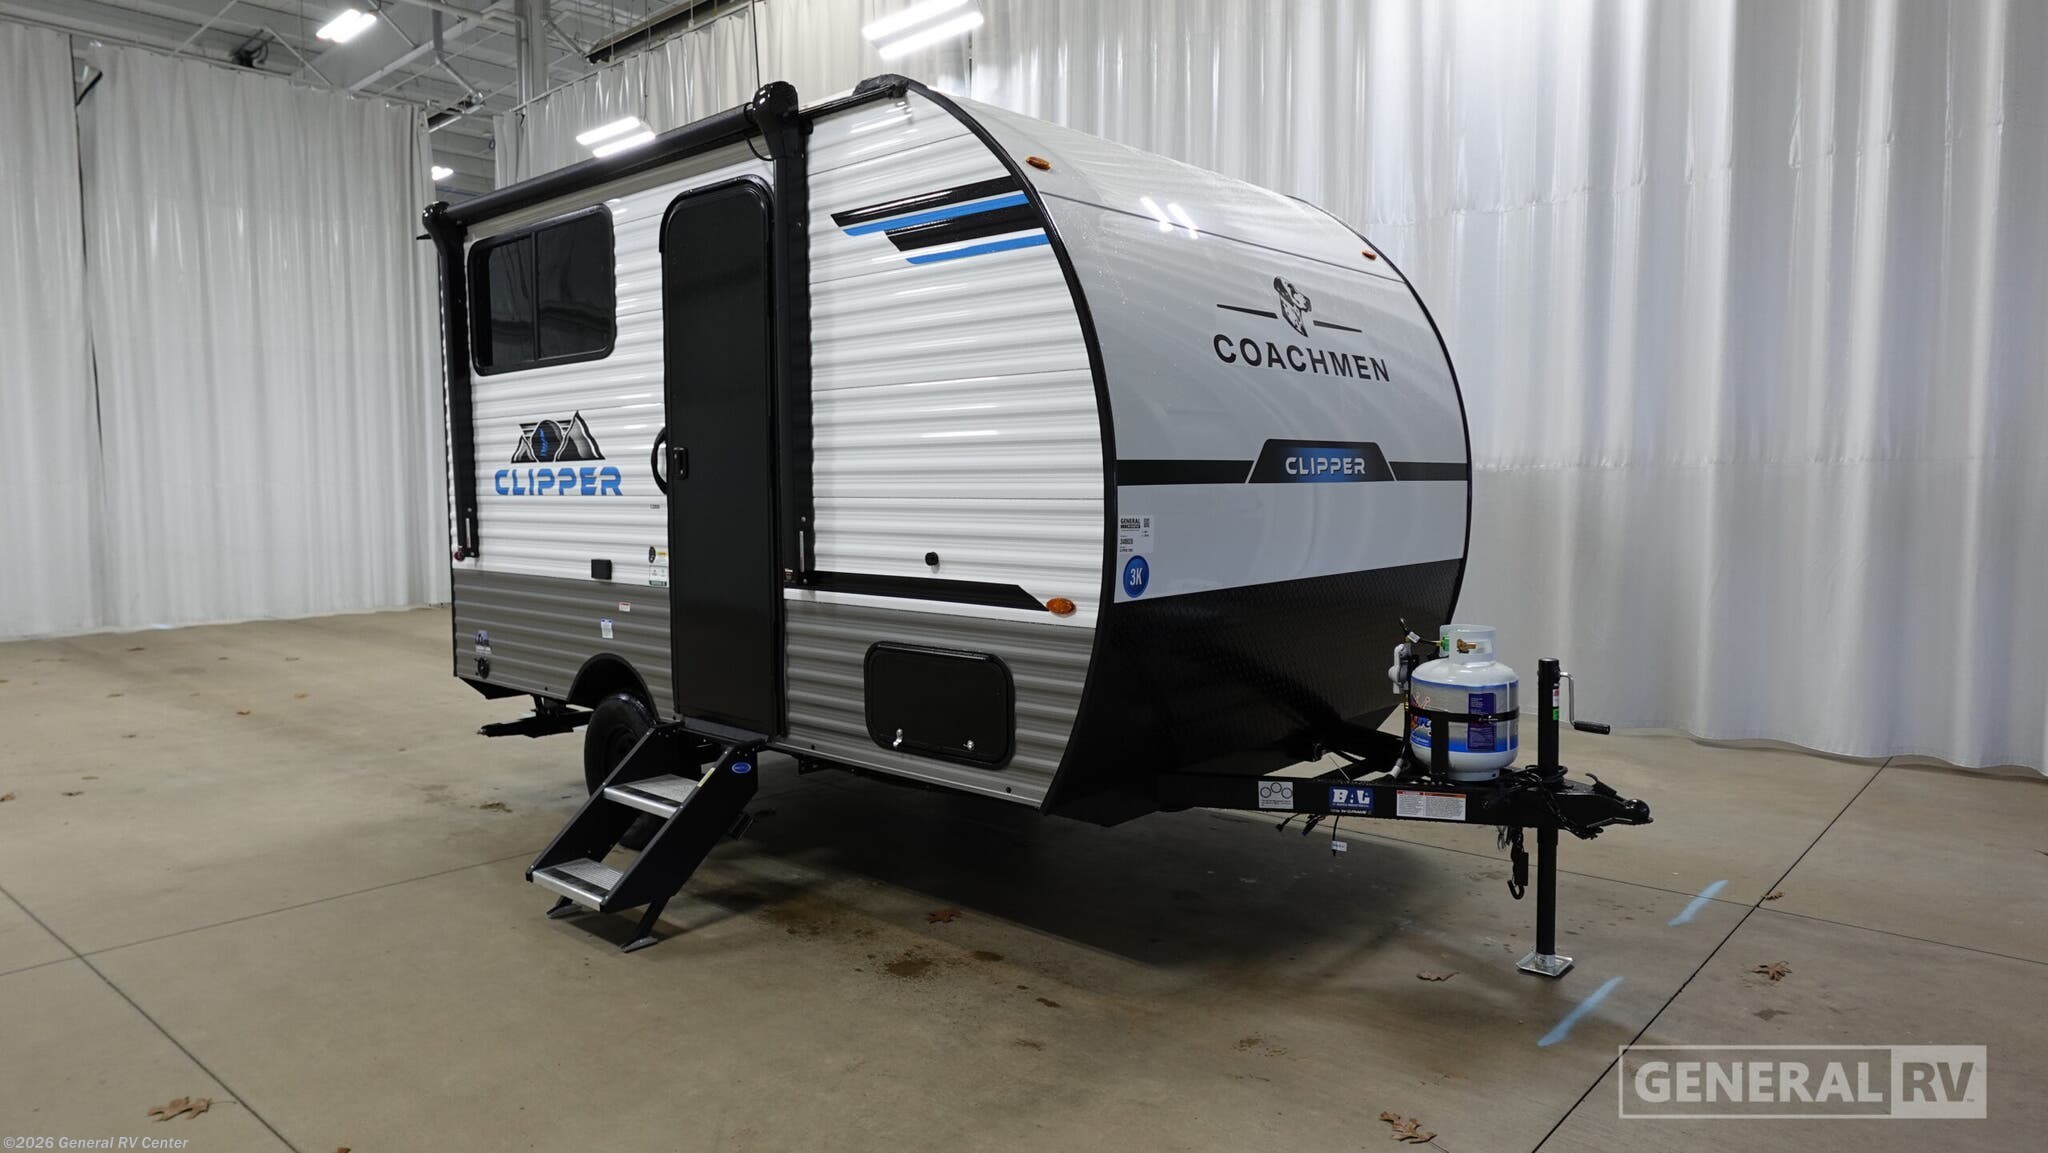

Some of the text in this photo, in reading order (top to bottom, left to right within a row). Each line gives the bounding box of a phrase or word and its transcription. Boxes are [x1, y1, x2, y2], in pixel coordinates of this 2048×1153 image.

[1213, 334, 1390, 382] COACHMEN
[1285, 456, 1366, 475] CLIPPER
[494, 466, 624, 496] CLIPPER
[1129, 567, 1143, 586] 3K
